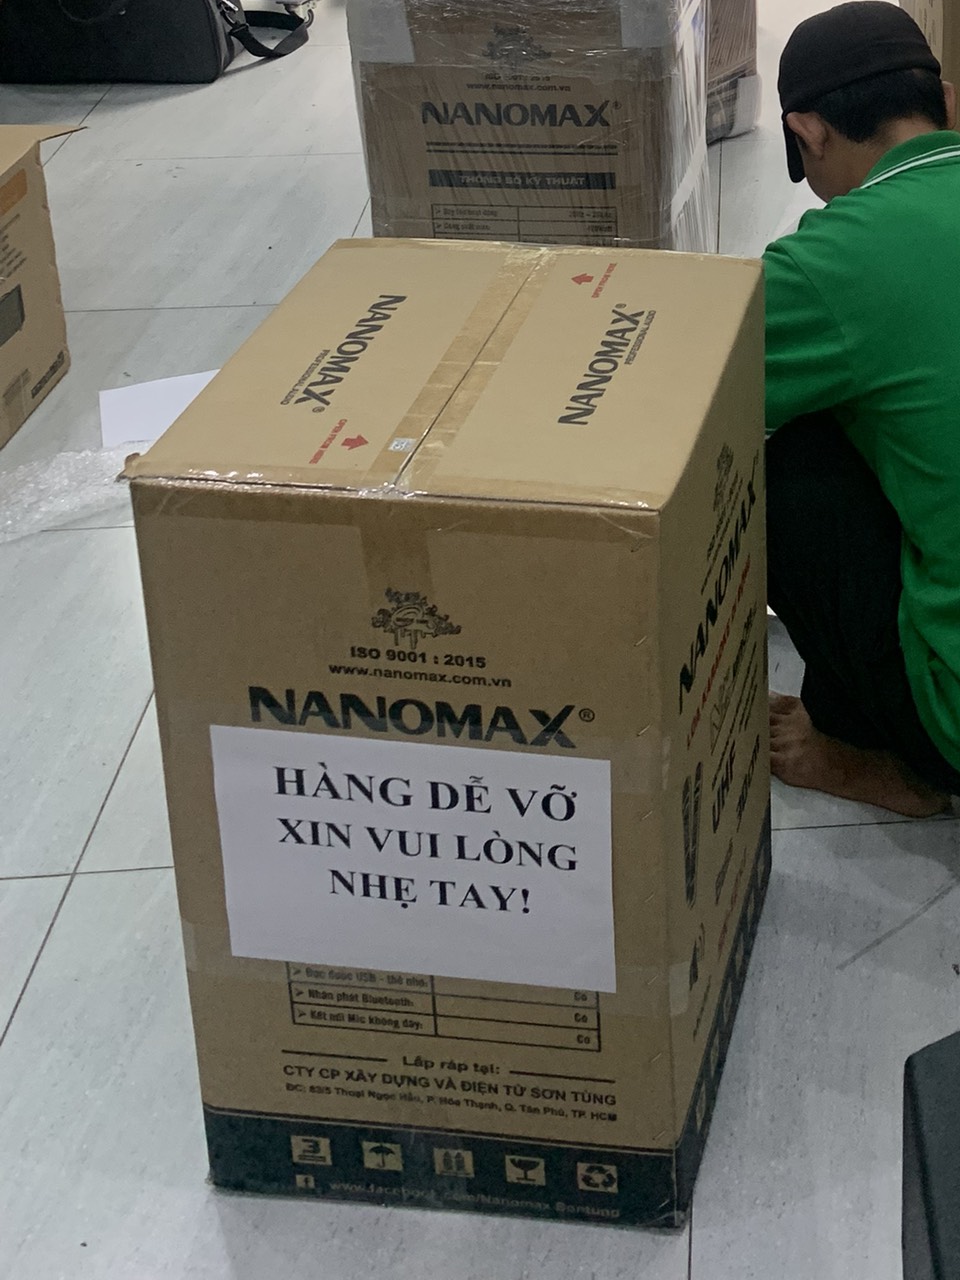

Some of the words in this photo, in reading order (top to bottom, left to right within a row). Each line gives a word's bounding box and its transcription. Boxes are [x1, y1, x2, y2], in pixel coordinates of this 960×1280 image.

[421, 99, 611, 128] NANOMAX
[294, 295, 408, 406] NANOMAX
[558, 309, 645, 426] NANOMAX
[679, 455, 758, 715] NANOMAX
[329, 662, 512, 689] www.nanomax.com.vn
[350, 645, 381, 660] ISO
[386, 648, 427, 664] 9001
[444, 652, 487, 669] 2015
[248, 685, 577, 749] NANOMAX
[273, 762, 413, 808] HÀNG
[429, 775, 492, 814] DỄ
[505, 784, 578, 823] VỠ
[278, 817, 352, 850] XIN
[366, 825, 440, 859] VUI
[455, 831, 579, 872] LÒNG
[329, 869, 418, 910] NHẸ
[429, 879, 531, 915] TAY!
[282, 1064, 315, 1079] CTY
[319, 1067, 340, 1080] CP
[345, 1068, 377, 1084] XÂY
[382, 1072, 431, 1090] DỰNG
[434, 1074, 457, 1091] VÀ
[461, 1077, 498, 1096] ĐIỆN
[502, 1080, 527, 1098] TỬ
[530, 1083, 567, 1101] SƠN
[571, 1087, 617, 1106] TÙNG
[402, 1052, 434, 1072] Lắp
[439, 1057, 469, 1074] ráp
[474, 1060, 500, 1075] tại:
